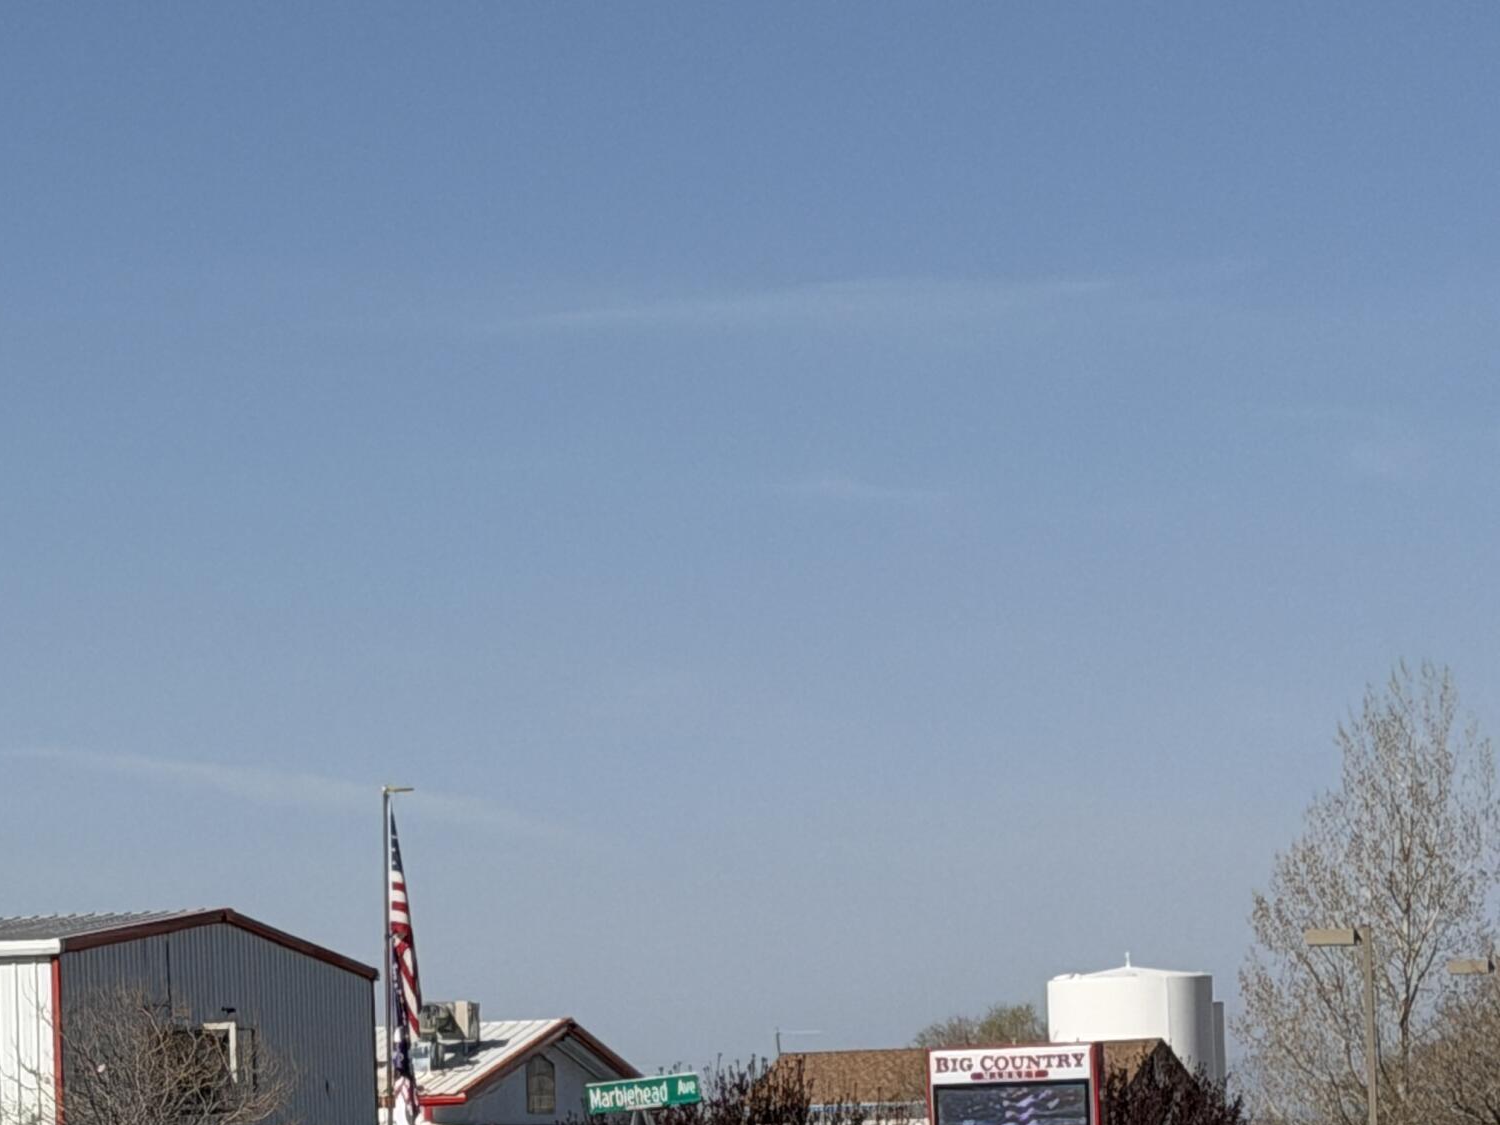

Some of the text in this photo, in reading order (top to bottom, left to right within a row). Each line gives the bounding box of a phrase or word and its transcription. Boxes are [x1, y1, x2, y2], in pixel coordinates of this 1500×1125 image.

[935, 1053, 1085, 1073] BIG COUNTRY
[589, 1080, 696, 1110] Marblehead Ave
